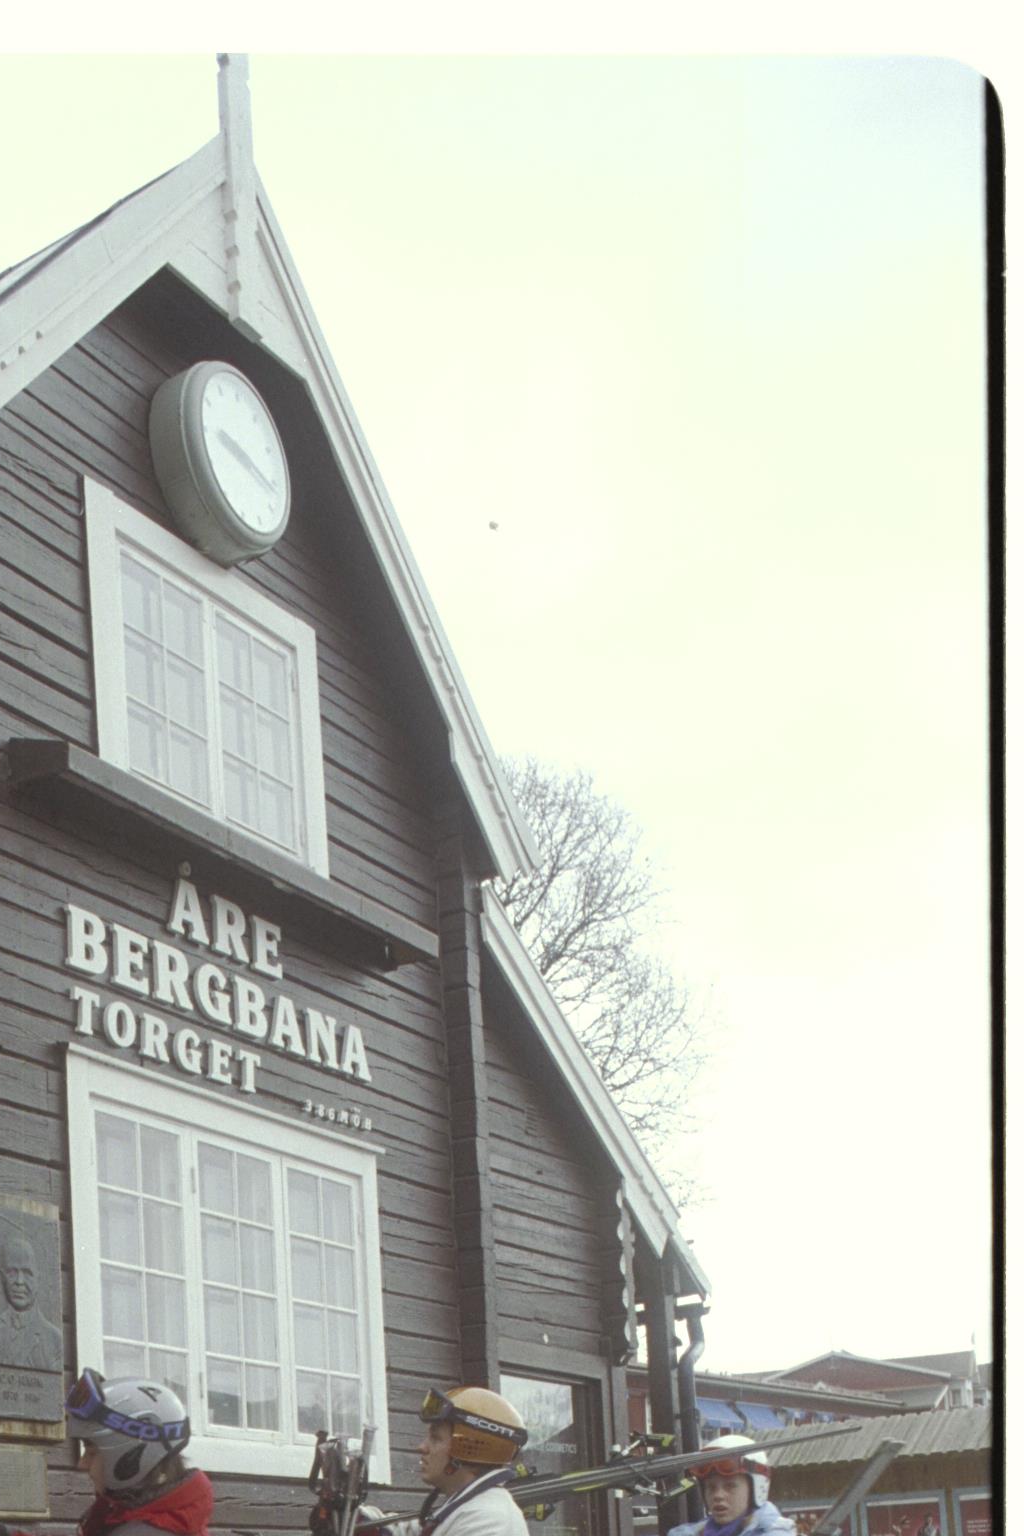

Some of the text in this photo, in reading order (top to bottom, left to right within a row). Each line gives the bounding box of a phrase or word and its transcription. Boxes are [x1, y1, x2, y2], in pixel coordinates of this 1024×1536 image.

[166, 860, 283, 980] ÅRE
[63, 902, 373, 1083] BERGBANA
[69, 985, 262, 1094] TORGET
[104, 1412, 185, 1440] SCOTT
[465, 1415, 516, 1437] SCOTT
